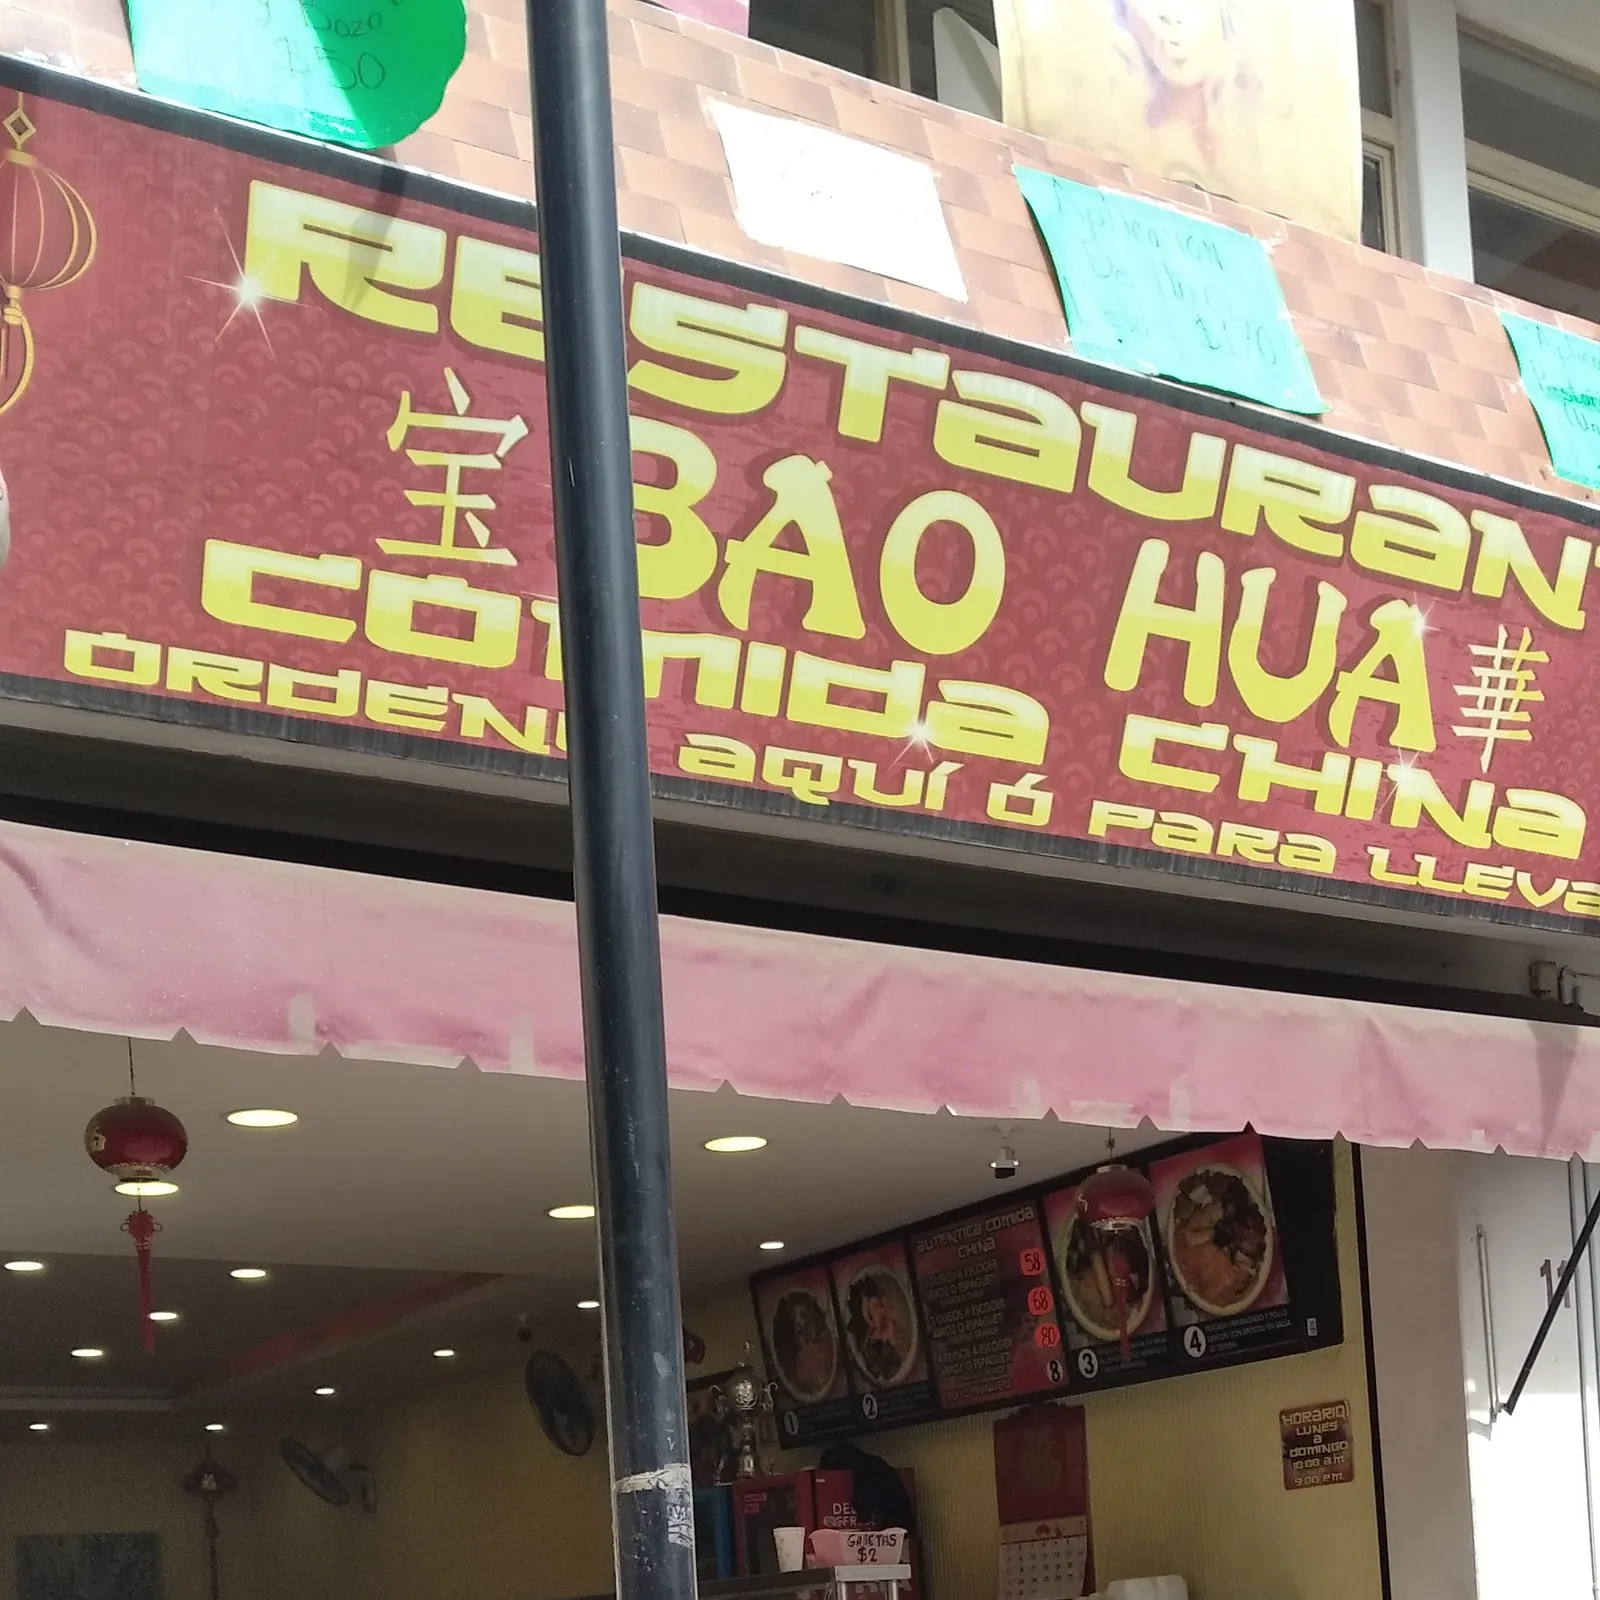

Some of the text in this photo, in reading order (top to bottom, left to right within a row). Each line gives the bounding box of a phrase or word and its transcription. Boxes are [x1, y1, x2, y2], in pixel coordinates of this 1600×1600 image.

[243, 179, 1600, 630] RESTAURAN
[375, 366, 530, 567] 宝
[630, 414, 1437, 753] BAO HUA
[201, 538, 1587, 861] COMIDA CHINA
[64, 629, 569, 756] ORDEN
[677, 733, 964, 806] AQUÍ
[1088, 799, 1336, 874] PARA
[1024, 1252, 1041, 1272] 58
[1033, 1290, 1049, 1311] 68
[1041, 1326, 1056, 1347] 80
[1296, 1420, 1338, 1436] LUNES
[1289, 1440, 1348, 1458] DOMINGO
[857, 1545, 878, 1564] $2
